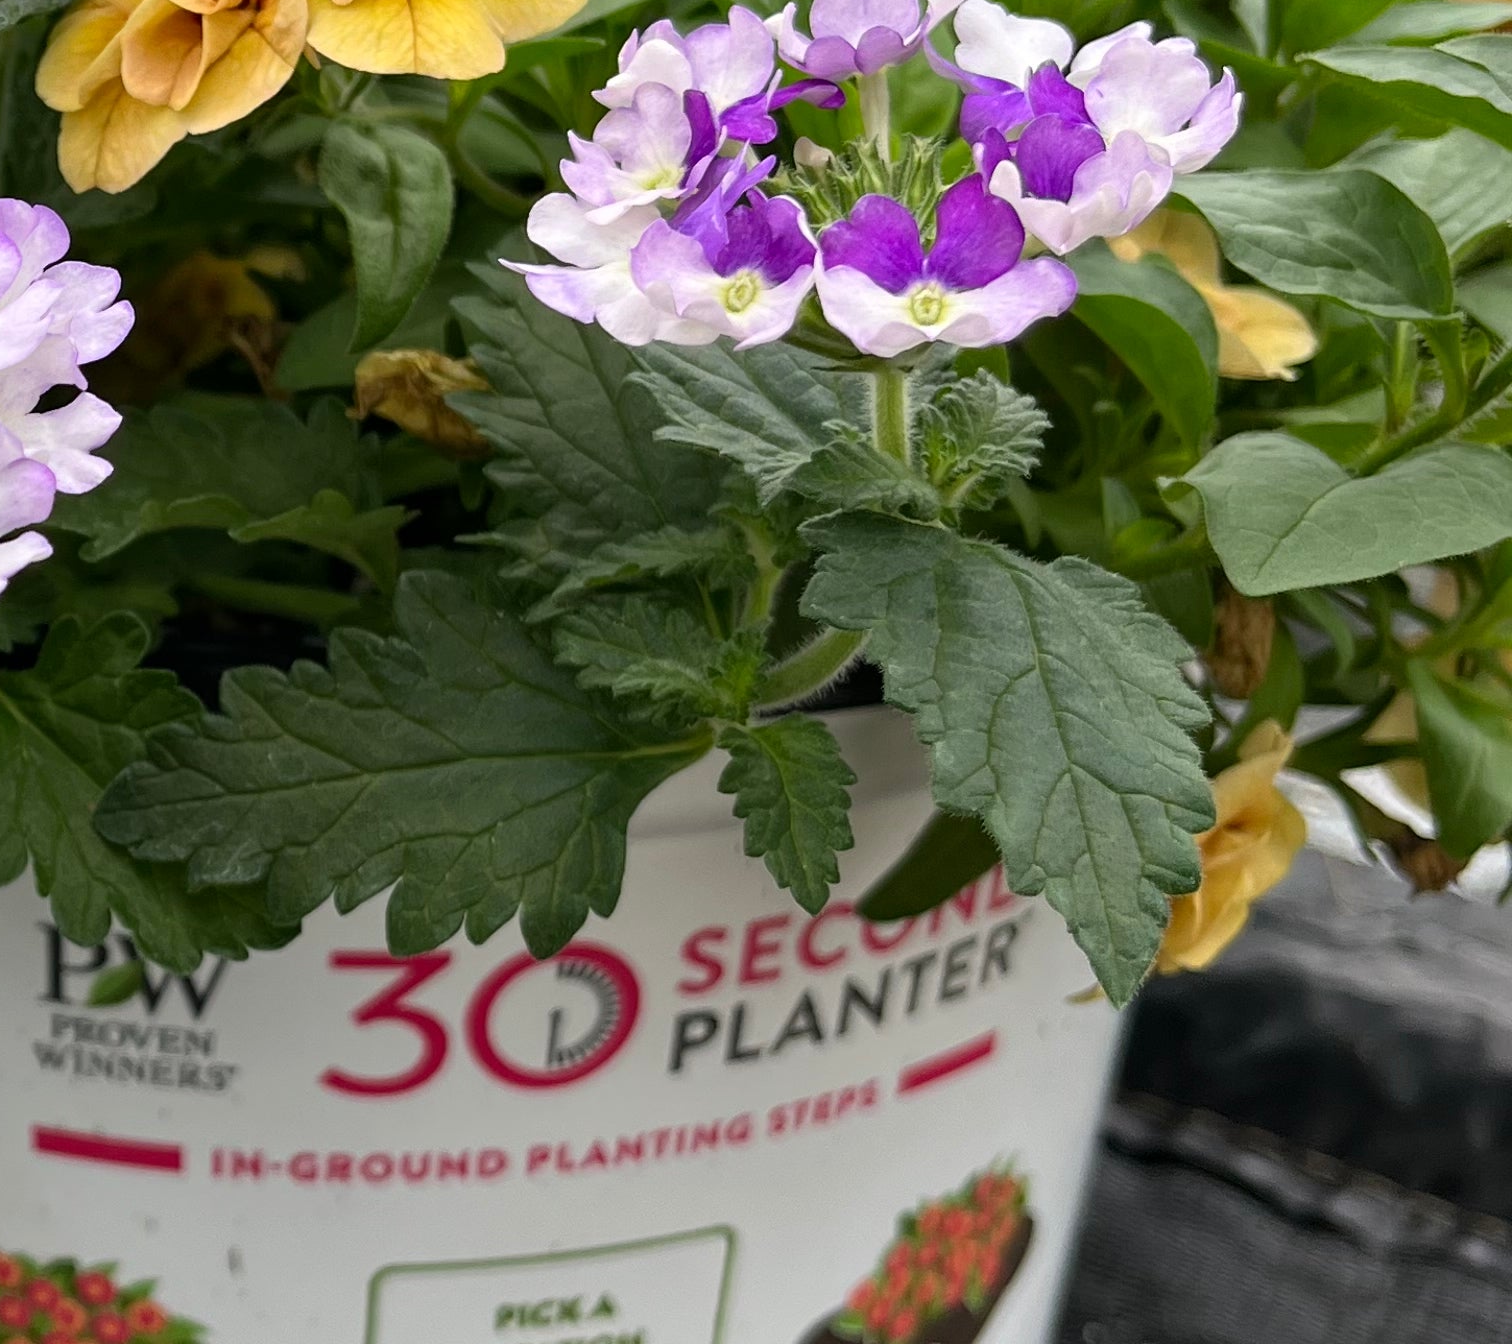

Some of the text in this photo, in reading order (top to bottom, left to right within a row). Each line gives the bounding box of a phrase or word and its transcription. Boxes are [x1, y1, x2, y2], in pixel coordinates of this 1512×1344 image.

[51, 1013, 217, 1056] PROVEN
[318, 941, 643, 1094] 30
[209, 1078, 879, 1186] IN-GROUND PLANTING STEPS
[494, 1293, 618, 1331] PICK A
